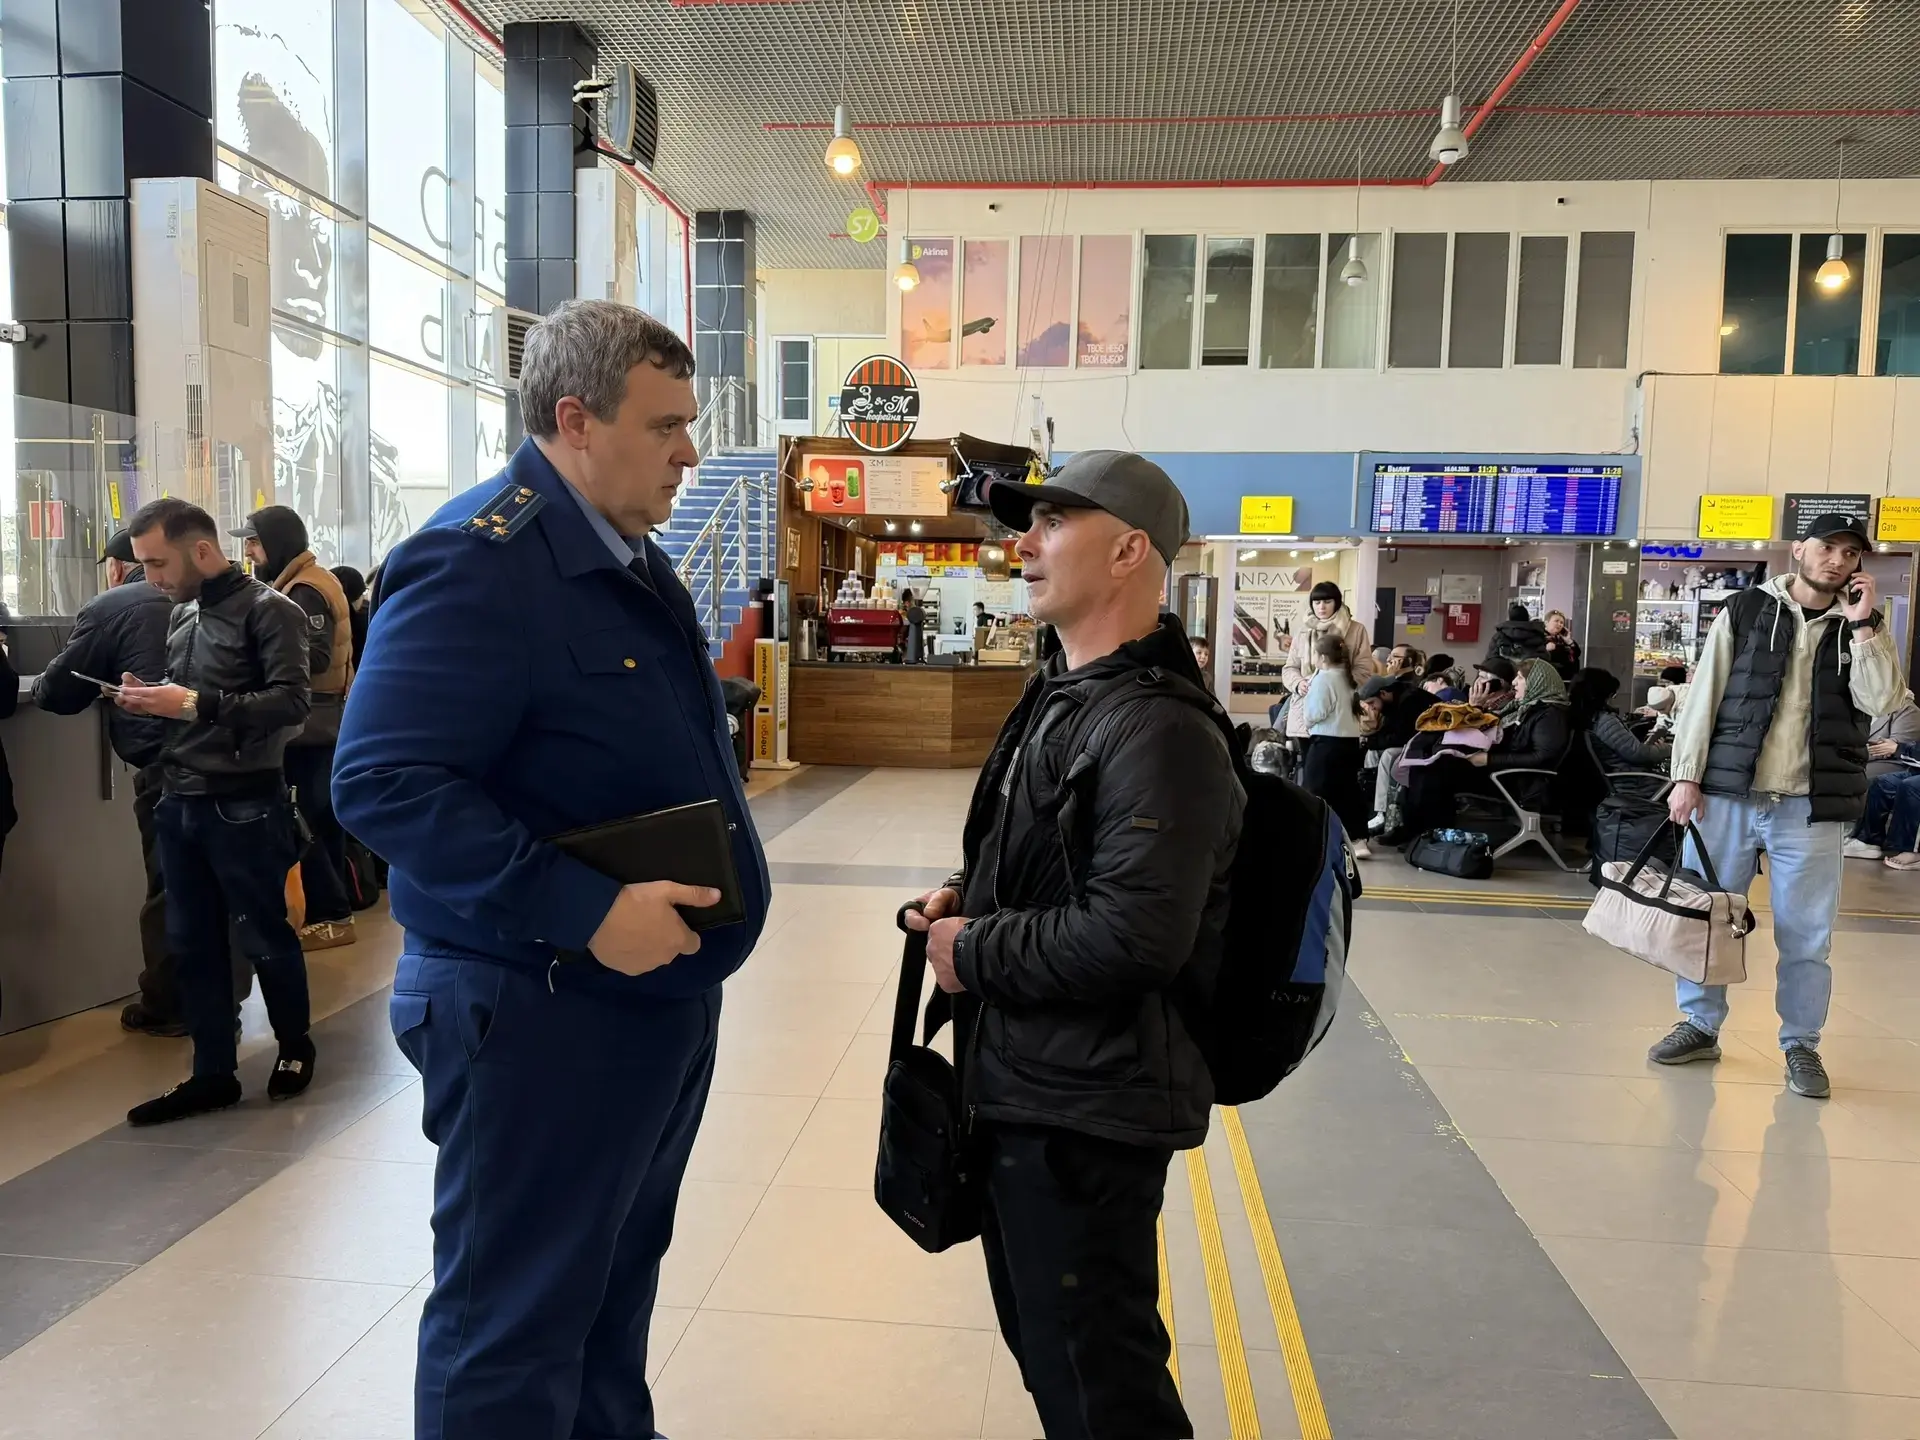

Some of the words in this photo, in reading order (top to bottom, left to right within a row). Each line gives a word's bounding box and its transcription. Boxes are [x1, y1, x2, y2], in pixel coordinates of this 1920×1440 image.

[922, 247, 948, 257] Airlines
[1086, 343, 1104, 353] ТВОЕ
[1081, 354, 1099, 364] ТВОЙ
[1100, 355, 1124, 364] ВЫБОР
[865, 409, 902, 423] кофейня
[1478, 465, 1498, 473] 11:28
[1602, 467, 1622, 475] 11:28
[1881, 504, 1902, 514] Выход
[1881, 522, 1897, 532] Gate
[760, 724, 769, 756] energo
